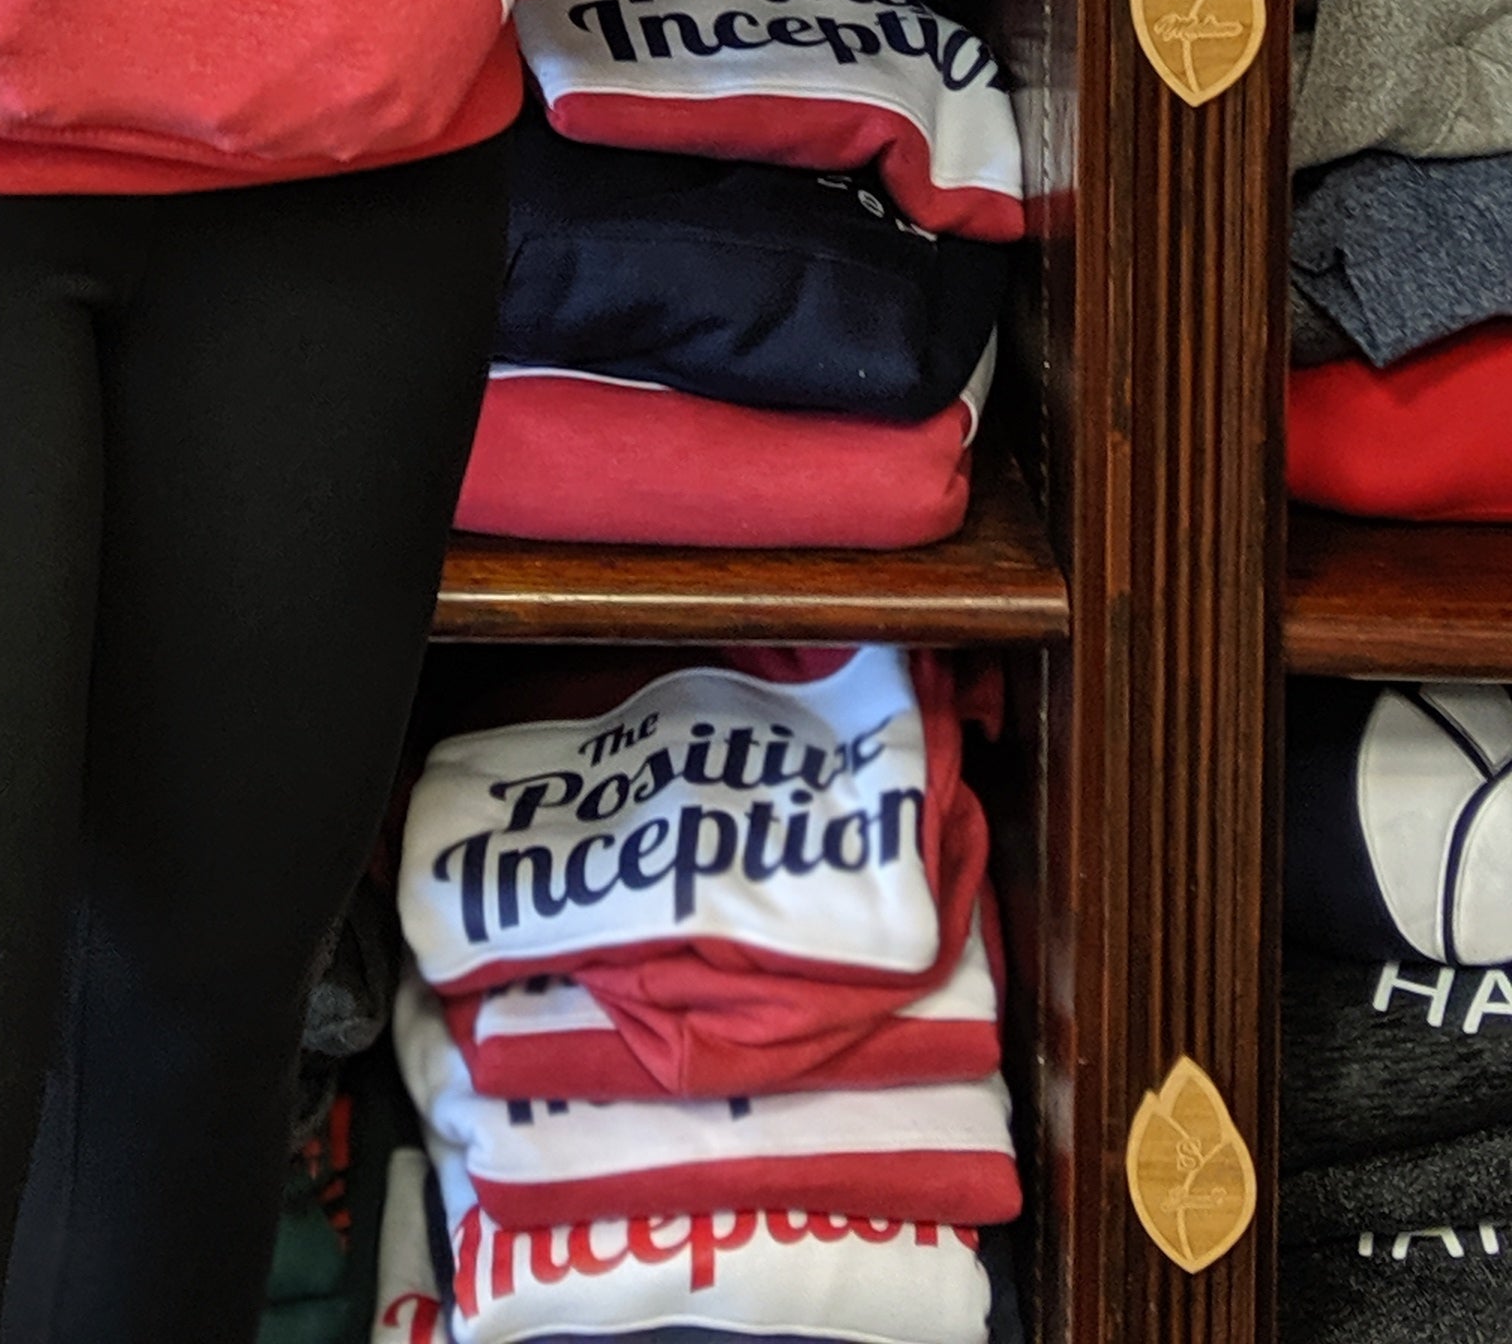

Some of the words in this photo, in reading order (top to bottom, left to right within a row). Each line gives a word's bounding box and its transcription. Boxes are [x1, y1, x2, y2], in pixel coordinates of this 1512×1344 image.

[490, 715, 893, 832] Positive
[579, 712, 660, 767] The
[432, 787, 925, 944] Inception
